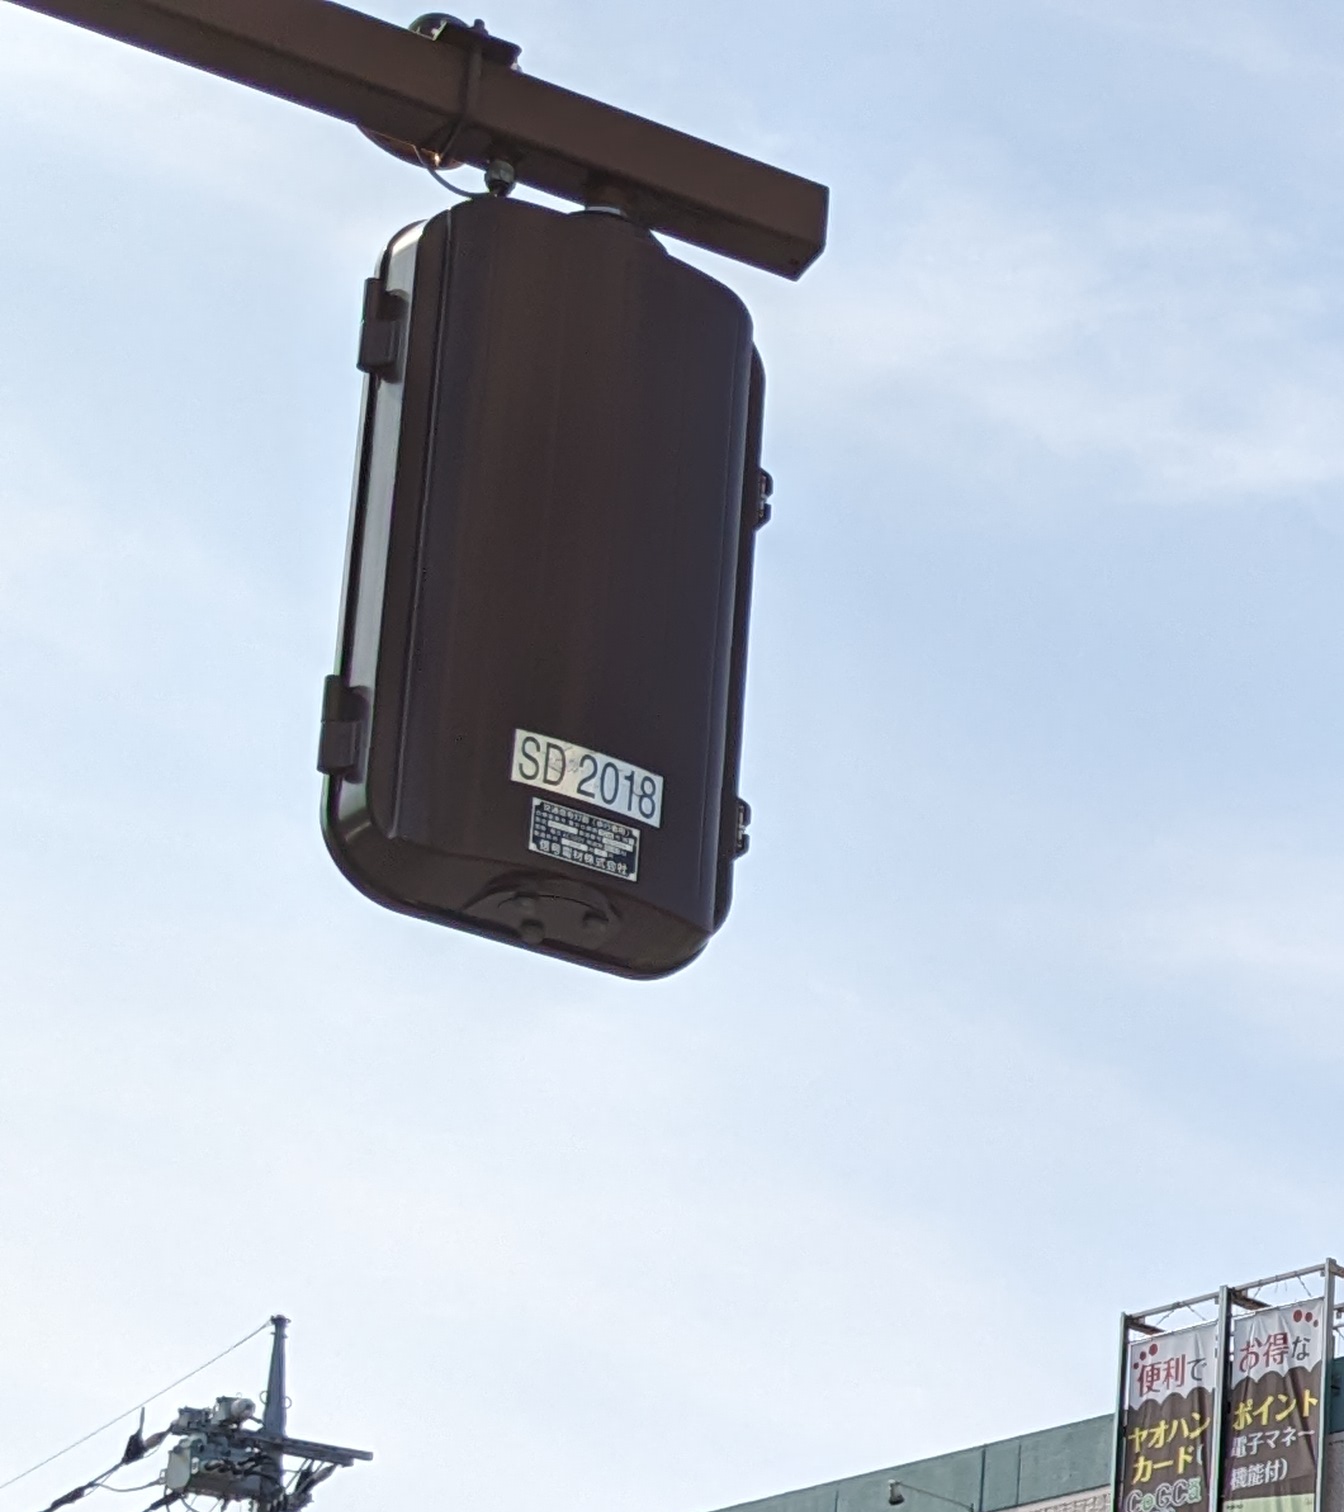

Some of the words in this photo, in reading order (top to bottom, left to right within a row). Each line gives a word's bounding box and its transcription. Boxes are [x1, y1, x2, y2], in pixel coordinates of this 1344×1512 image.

[519, 735, 567, 786] SD
[575, 754, 659, 819] 2018
[1239, 1332, 1310, 1374] お得な
[1137, 1353, 1207, 1397] 便利で
[1128, 1411, 1211, 1450] ヤオハン
[1233, 1388, 1319, 1431] ポイント
[1230, 1427, 1316, 1459] 電子マネー
